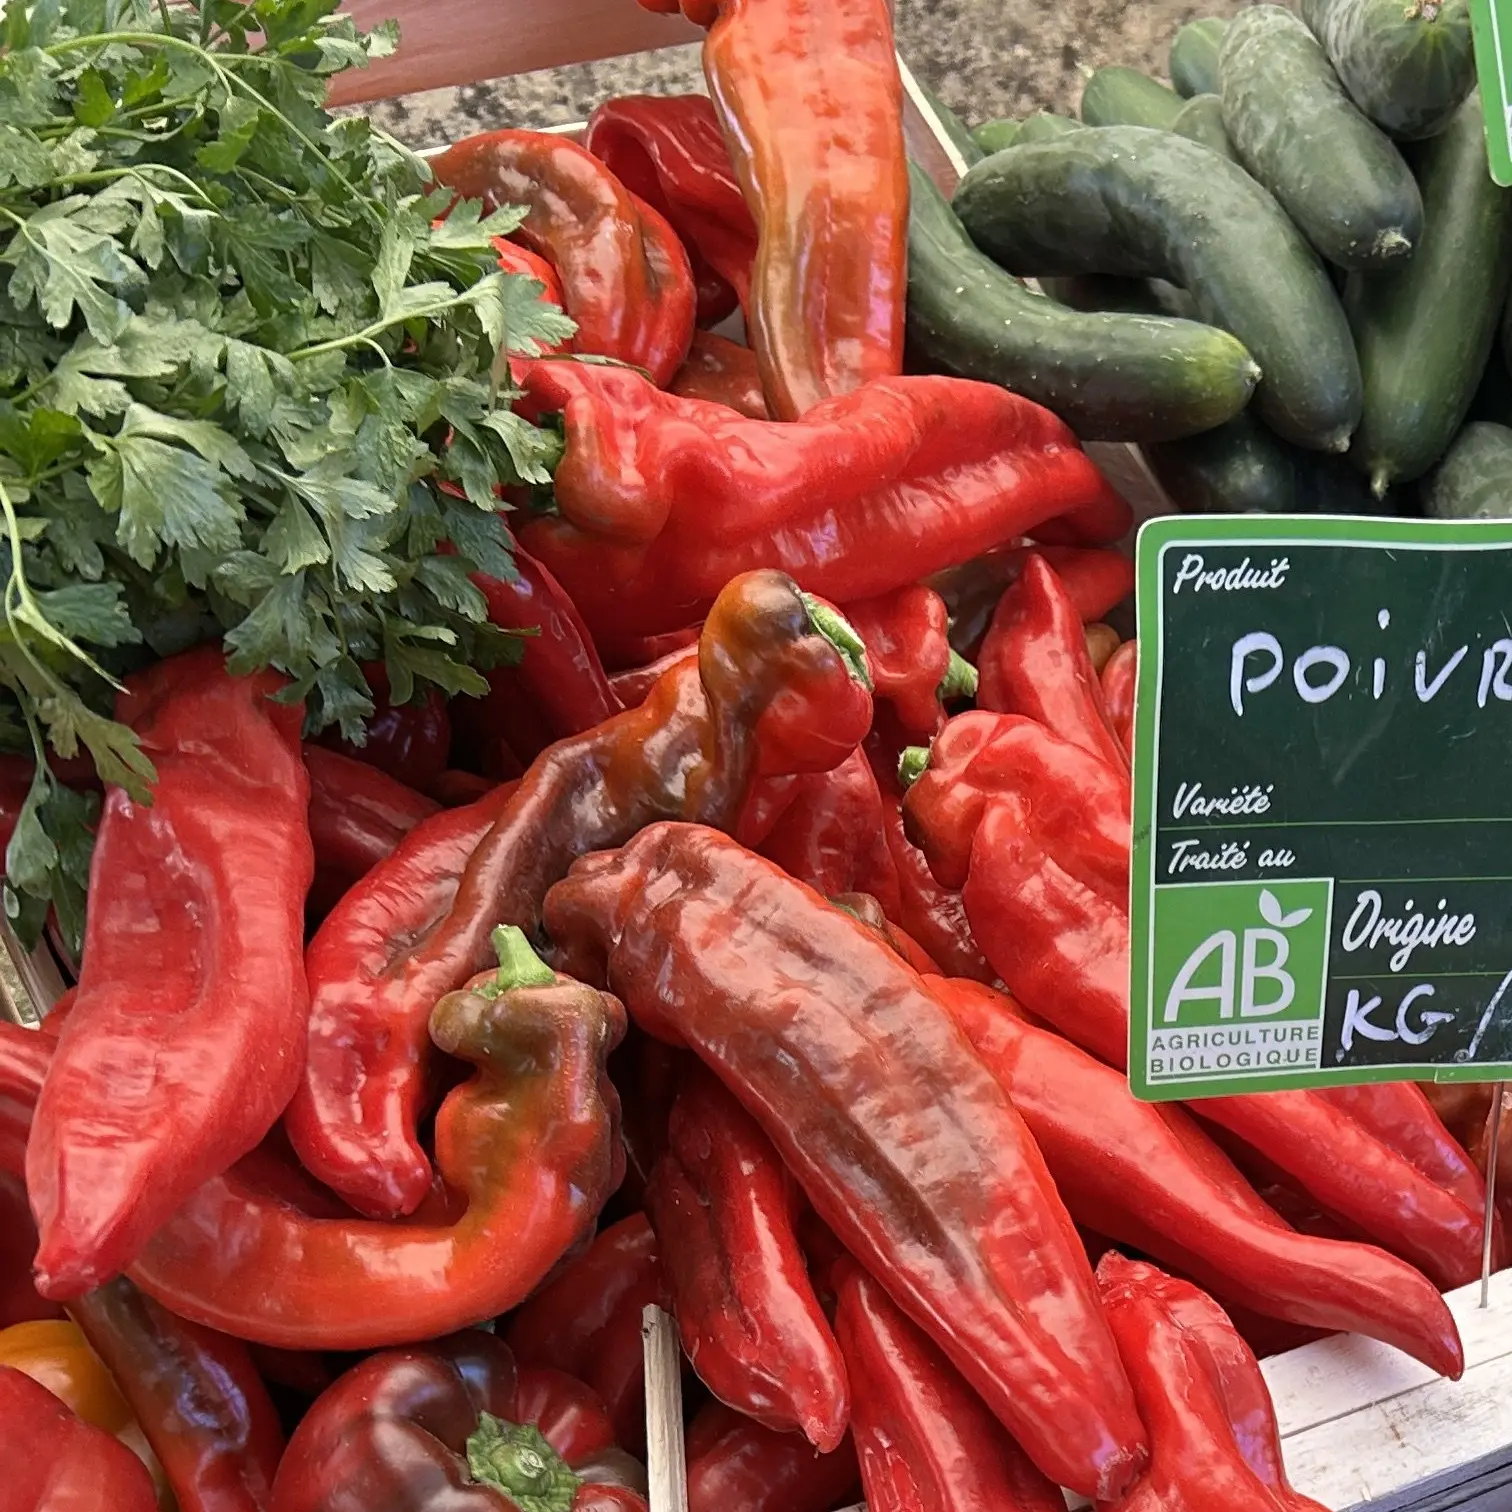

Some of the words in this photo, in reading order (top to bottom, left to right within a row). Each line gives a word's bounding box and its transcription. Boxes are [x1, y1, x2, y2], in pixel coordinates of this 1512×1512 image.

[1173, 554, 1290, 594] Produit
[1172, 782, 1275, 820] Variété
[1167, 839, 1251, 875] Traité
[1257, 846, 1297, 869] au
[1341, 889, 1476, 972] Origine
[1163, 928, 1296, 1023] AB
[1151, 1026, 1320, 1052] AGRICULTURE
[1150, 1048, 1317, 1073] BIOLOGIQUE
